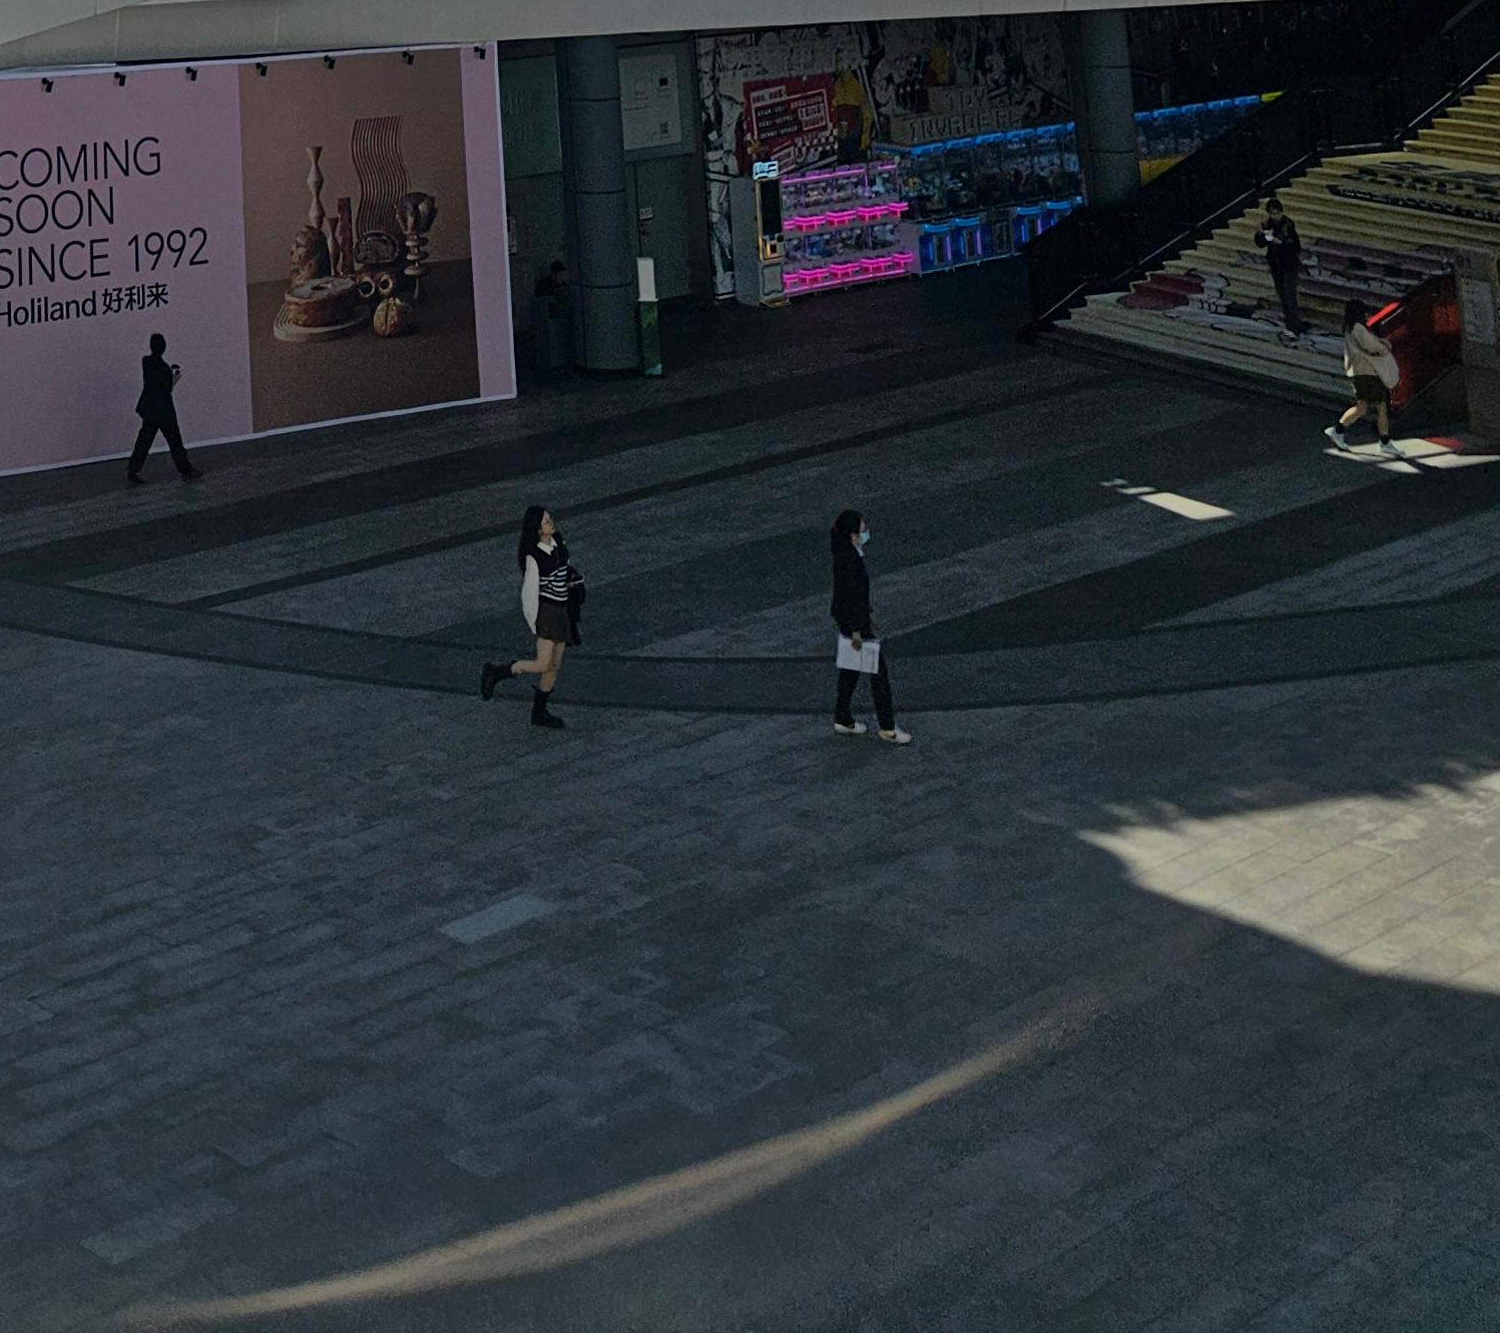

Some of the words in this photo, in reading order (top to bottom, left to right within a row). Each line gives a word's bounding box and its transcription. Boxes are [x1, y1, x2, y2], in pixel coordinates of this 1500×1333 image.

[127, 227, 209, 273] 1992
[102, 282, 169, 315] 好利来
